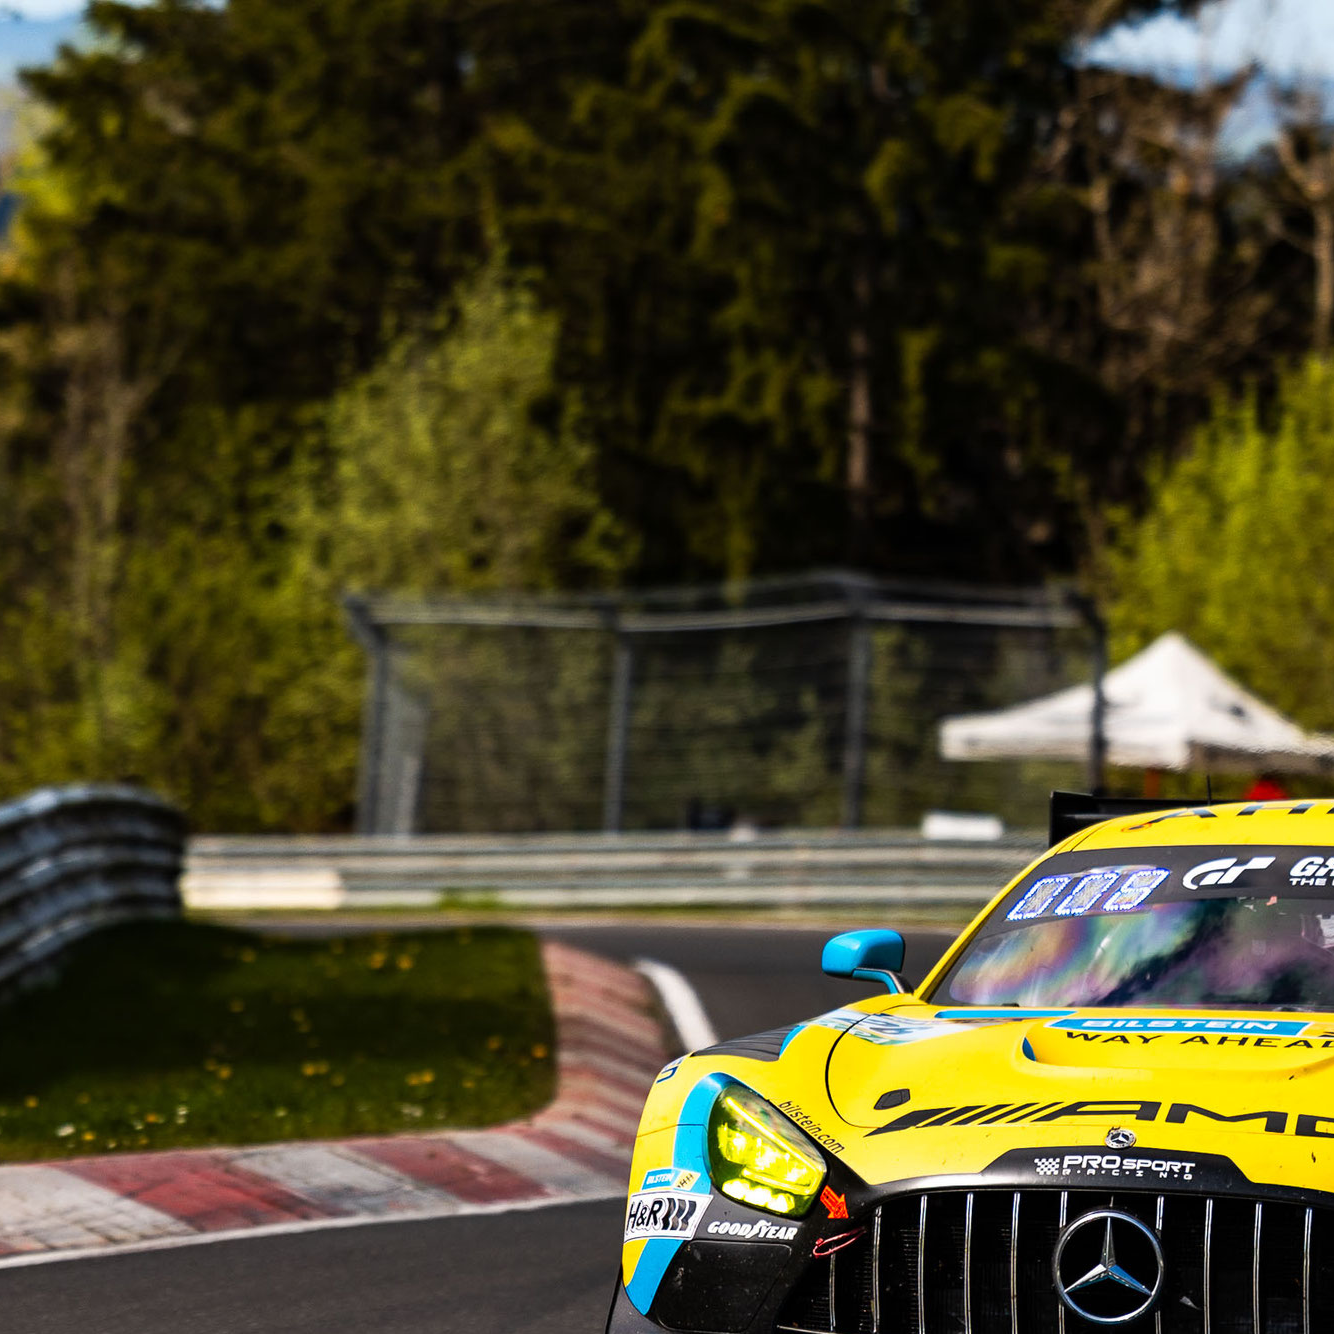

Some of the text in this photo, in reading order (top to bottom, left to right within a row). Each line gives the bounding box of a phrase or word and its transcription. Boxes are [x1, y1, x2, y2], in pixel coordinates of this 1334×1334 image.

[1289, 877, 1327, 888] THE
[1081, 1019, 1279, 1032] BILSTEIN
[1066, 1031, 1165, 1045] WAY
[778, 1100, 846, 1155] bilstein.com
[628, 1199, 663, 1233] H&R
[707, 1219, 798, 1241] GOODYEAR
